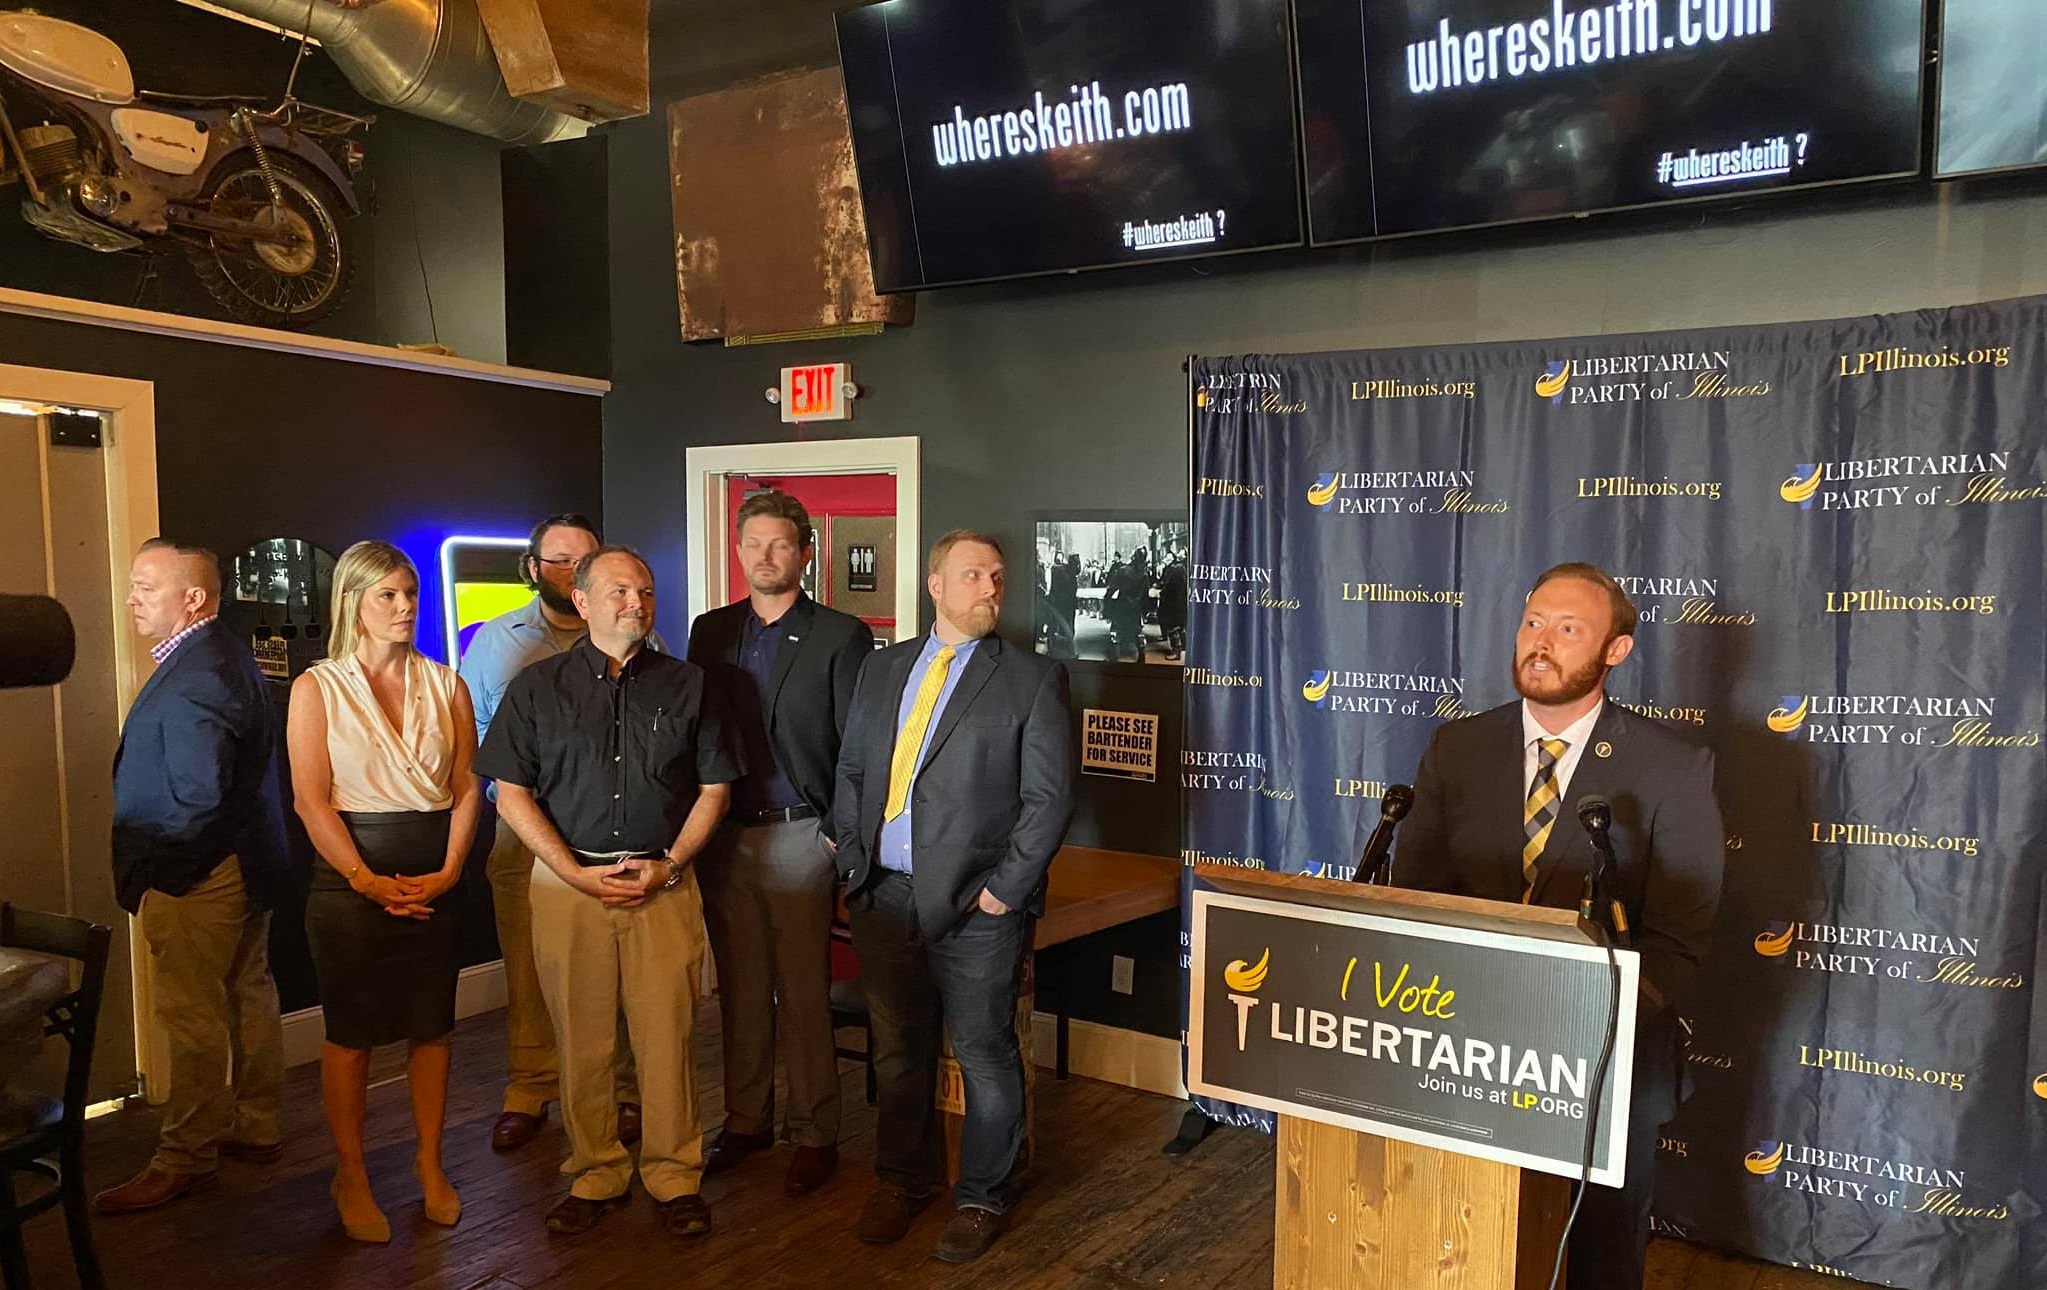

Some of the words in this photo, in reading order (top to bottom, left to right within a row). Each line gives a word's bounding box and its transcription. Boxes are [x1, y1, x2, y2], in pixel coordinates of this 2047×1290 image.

[1406, 0, 1772, 94] whereskeith.com
[932, 81, 1192, 167] whereskeith.com
[1657, 137, 1790, 186] #whereskeith
[1795, 132, 1808, 166] ?
[1122, 212, 1216, 250] #whereskeith
[1217, 209, 1226, 236] ?
[1571, 351, 1730, 378] LIBERTARIAN
[1839, 346, 2011, 377] LPIllinois.org
[791, 366, 836, 416] EXIT
[1351, 378, 1476, 400] LPIllinois.org
[1569, 383, 1646, 405] PARTY
[1649, 381, 1673, 400] of
[1675, 371, 1773, 401] Illinois
[1339, 470, 1476, 489] LIBERTARIAN
[1823, 452, 2010, 481] LIBERTARIAN
[1338, 496, 1405, 514] PARTY
[1408, 495, 1430, 514] of
[1429, 487, 1510, 515] Illinois
[1577, 476, 1722, 500] LPIllinois.org
[1822, 486, 1910, 511] PARTY
[1915, 485, 1942, 506] of
[1188, 588, 1235, 605] ARTY
[1237, 589, 1253, 605] of
[1342, 583, 1464, 608] LPIllinois.org
[1612, 576, 1719, 597] RTARIAN
[1639, 604, 1661, 623] of
[1662, 596, 1758, 626] Illinois
[1826, 589, 1996, 615] LPIllinois.org
[1331, 670, 1466, 695] LIBERTARIAN
[1330, 694, 1398, 716] PARTY
[1401, 700, 1420, 716] of
[1809, 694, 1996, 718] LIBERTARIAN
[1087, 714, 1131, 732] PLEASE
[1132, 718, 1154, 735] SEE
[1808, 724, 1896, 745] PARTY
[1900, 726, 1927, 746] of
[1930, 716, 2042, 749] Illinois
[1087, 731, 1152, 751] BARTENDER
[1086, 747, 1107, 762] FOR
[1109, 749, 1152, 767] SERVICE
[1229, 775, 1247, 791] of
[1811, 821, 1980, 856] LPIllinois.org
[1796, 922, 1980, 957] LIBERTARIAN
[1795, 950, 1882, 977] PARTY
[1886, 960, 1912, 980] of
[1916, 954, 2024, 989] Illinois
[1340, 955, 1358, 1001] I
[1373, 961, 1457, 1020] Vote
[1269, 1001, 1588, 1099] LIBERTARIAN
[1799, 1044, 1966, 1092] LPIllinois.org
[1417, 1073, 1457, 1095] Join
[1461, 1084, 1484, 1101] us
[1488, 1088, 1508, 1105] at
[1511, 1090, 1585, 1120] LP.ORG
[1783, 1143, 1967, 1190] LIBERTARIAN
[1783, 1169, 1870, 1202] PARTY
[1873, 1189, 1900, 1209] of
[1902, 1187, 2010, 1221] Illinois
